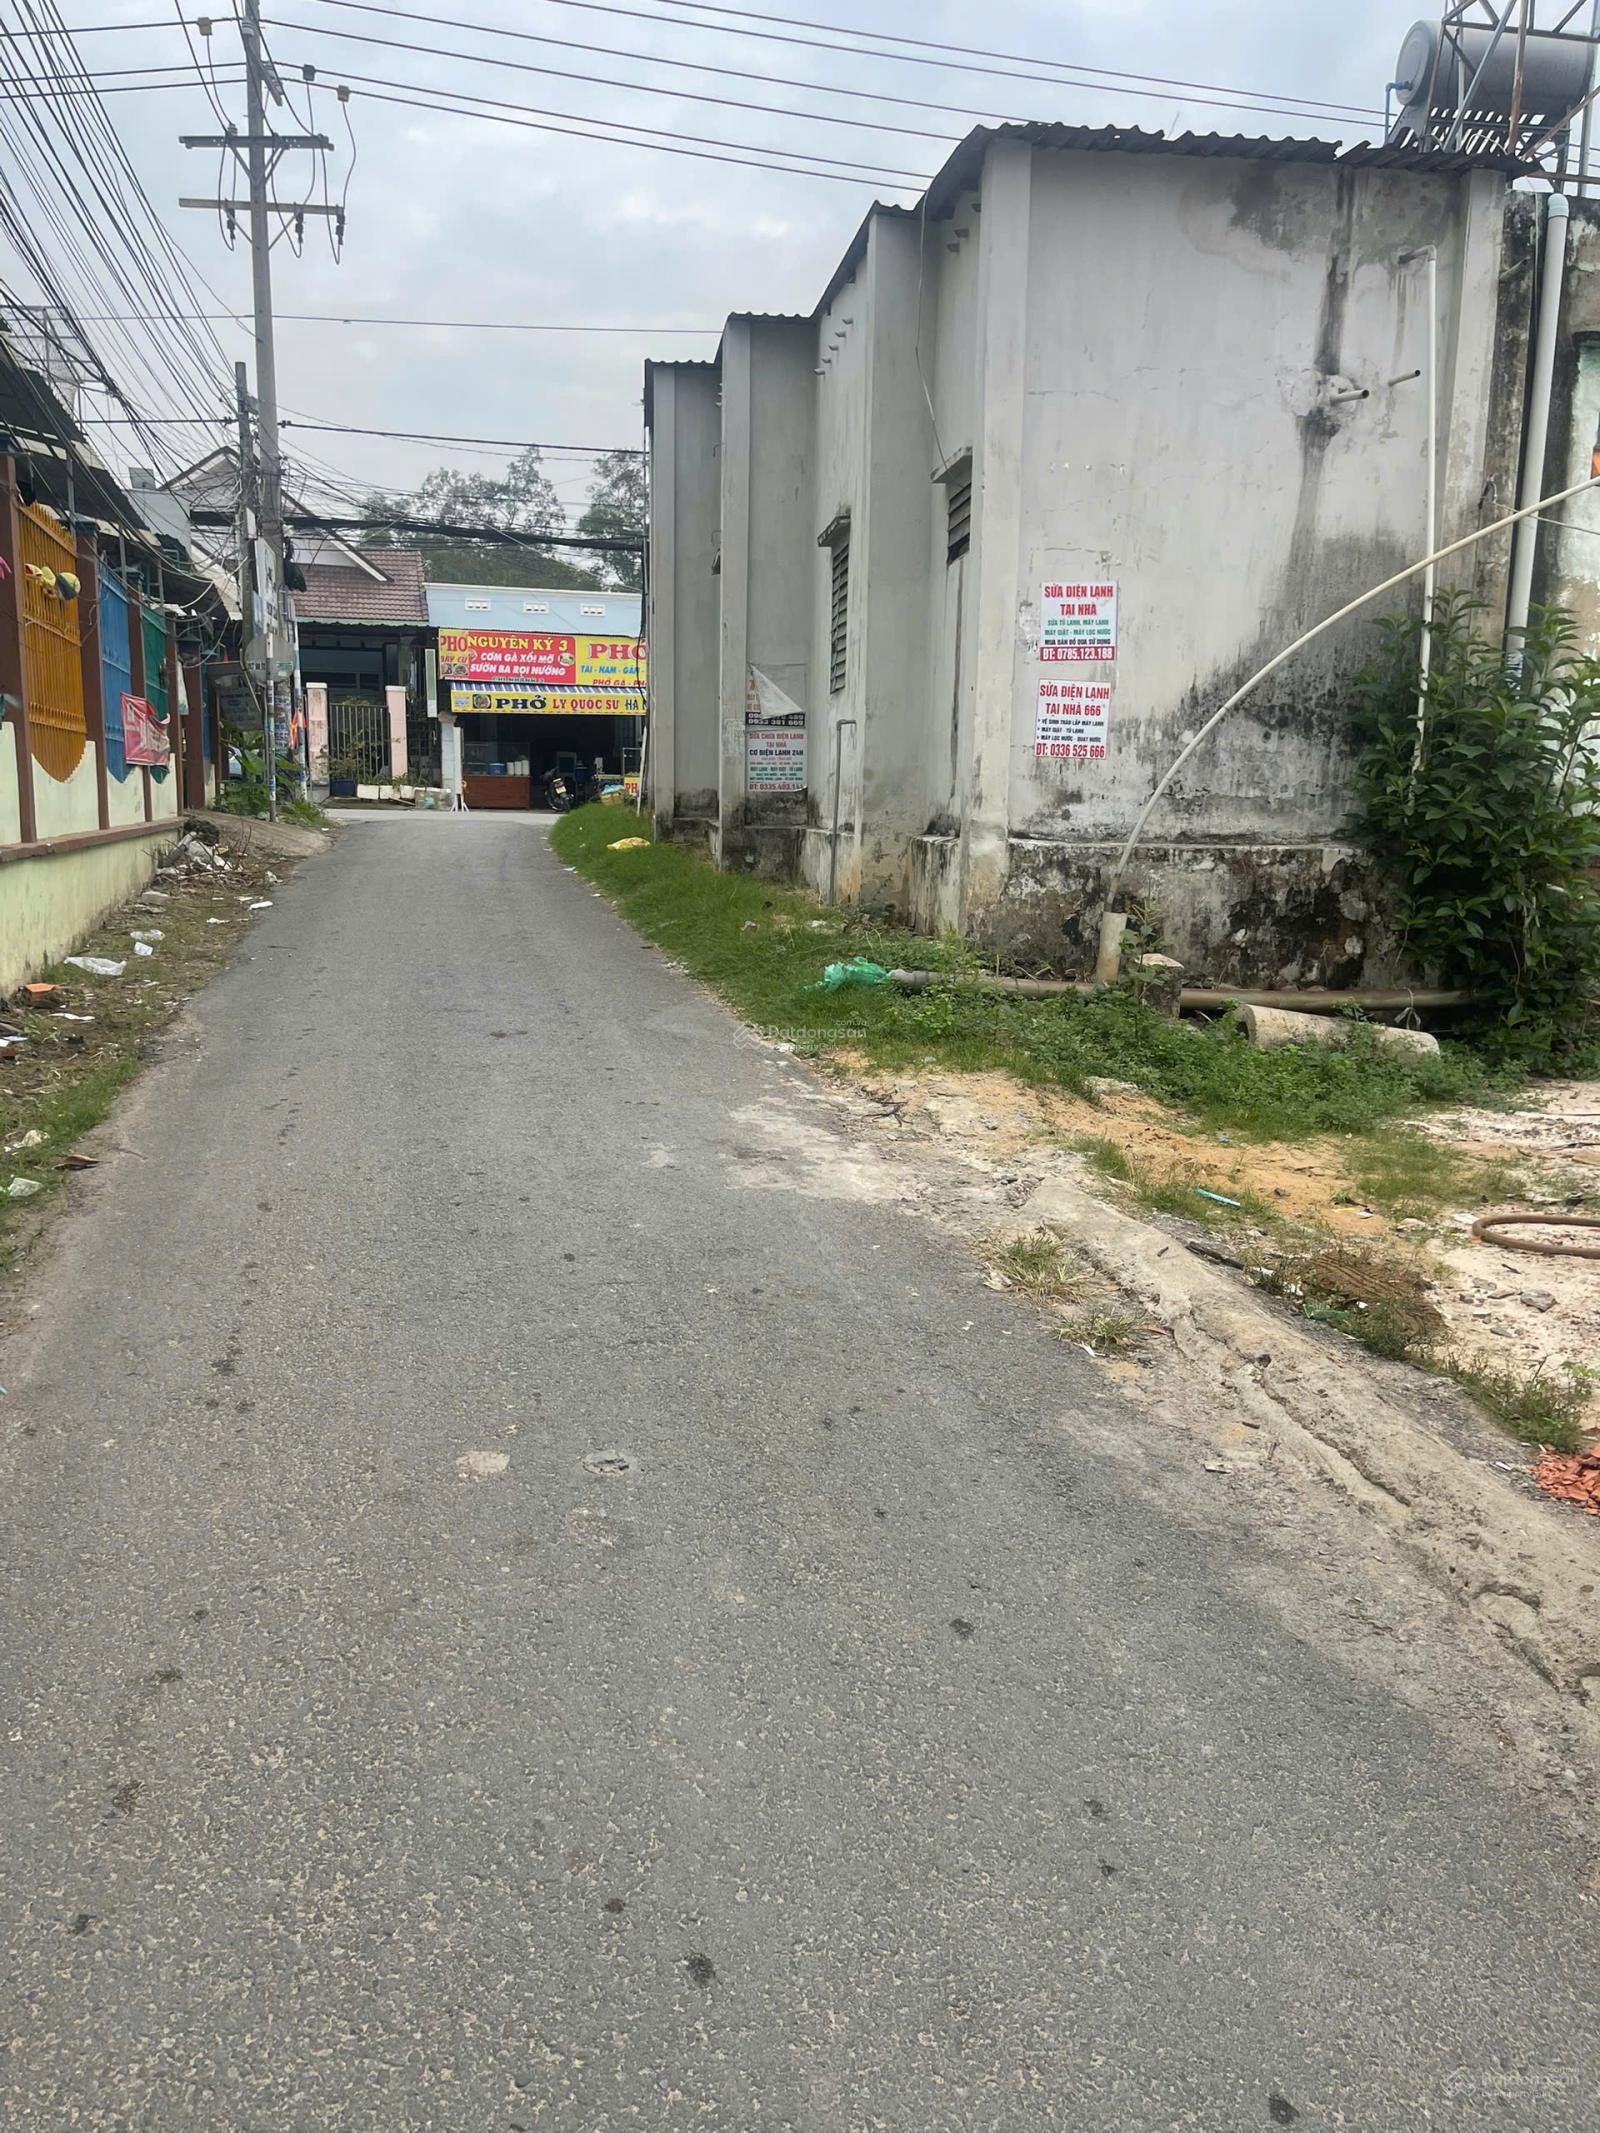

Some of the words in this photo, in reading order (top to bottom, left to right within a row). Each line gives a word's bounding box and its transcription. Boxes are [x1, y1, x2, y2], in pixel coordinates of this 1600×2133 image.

[559, 640, 568, 651] 3
[498, 664, 511, 674] BA
[496, 695, 546, 709] PHỞ
[1084, 705, 1101, 716] 666
[1050, 743, 1070, 756] 0336
[1072, 745, 1087, 757] 525
[1090, 745, 1104, 758] 666
